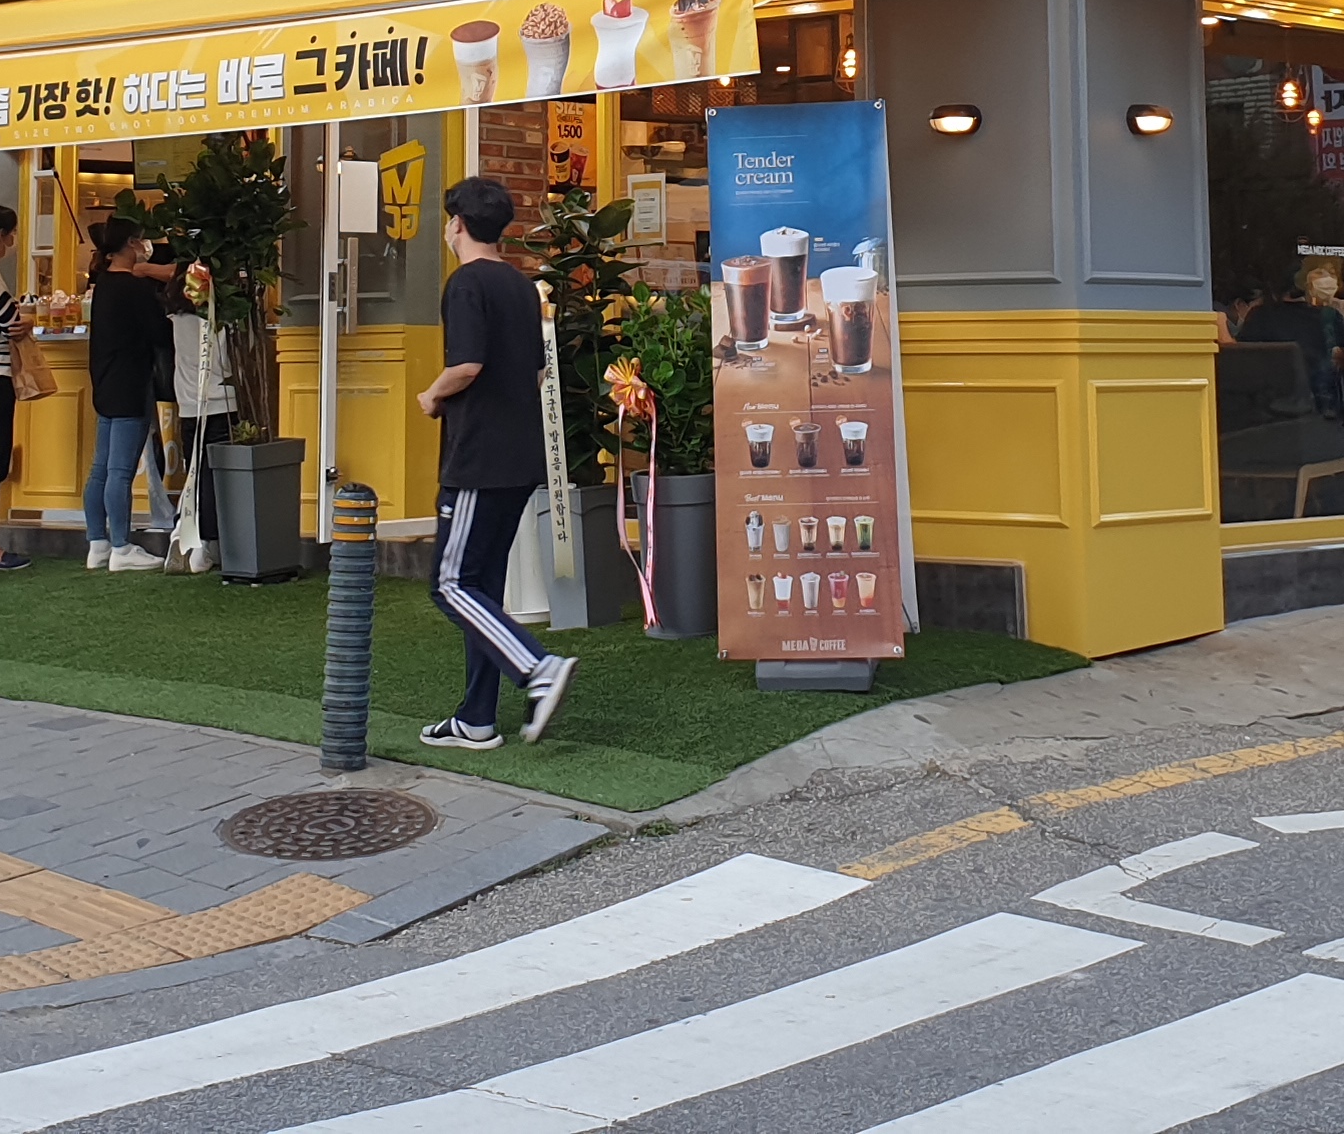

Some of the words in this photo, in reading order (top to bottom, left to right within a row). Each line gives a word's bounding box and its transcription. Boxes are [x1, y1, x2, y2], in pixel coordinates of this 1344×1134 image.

[16, 79, 70, 123] 가장
[74, 76, 116, 116] 핫!
[122, 68, 206, 114] 하다는
[217, 53, 287, 105] 바로
[733, 151, 795, 170] Tender
[734, 171, 794, 186] cream
[819, 638, 847, 652] COFFEE
